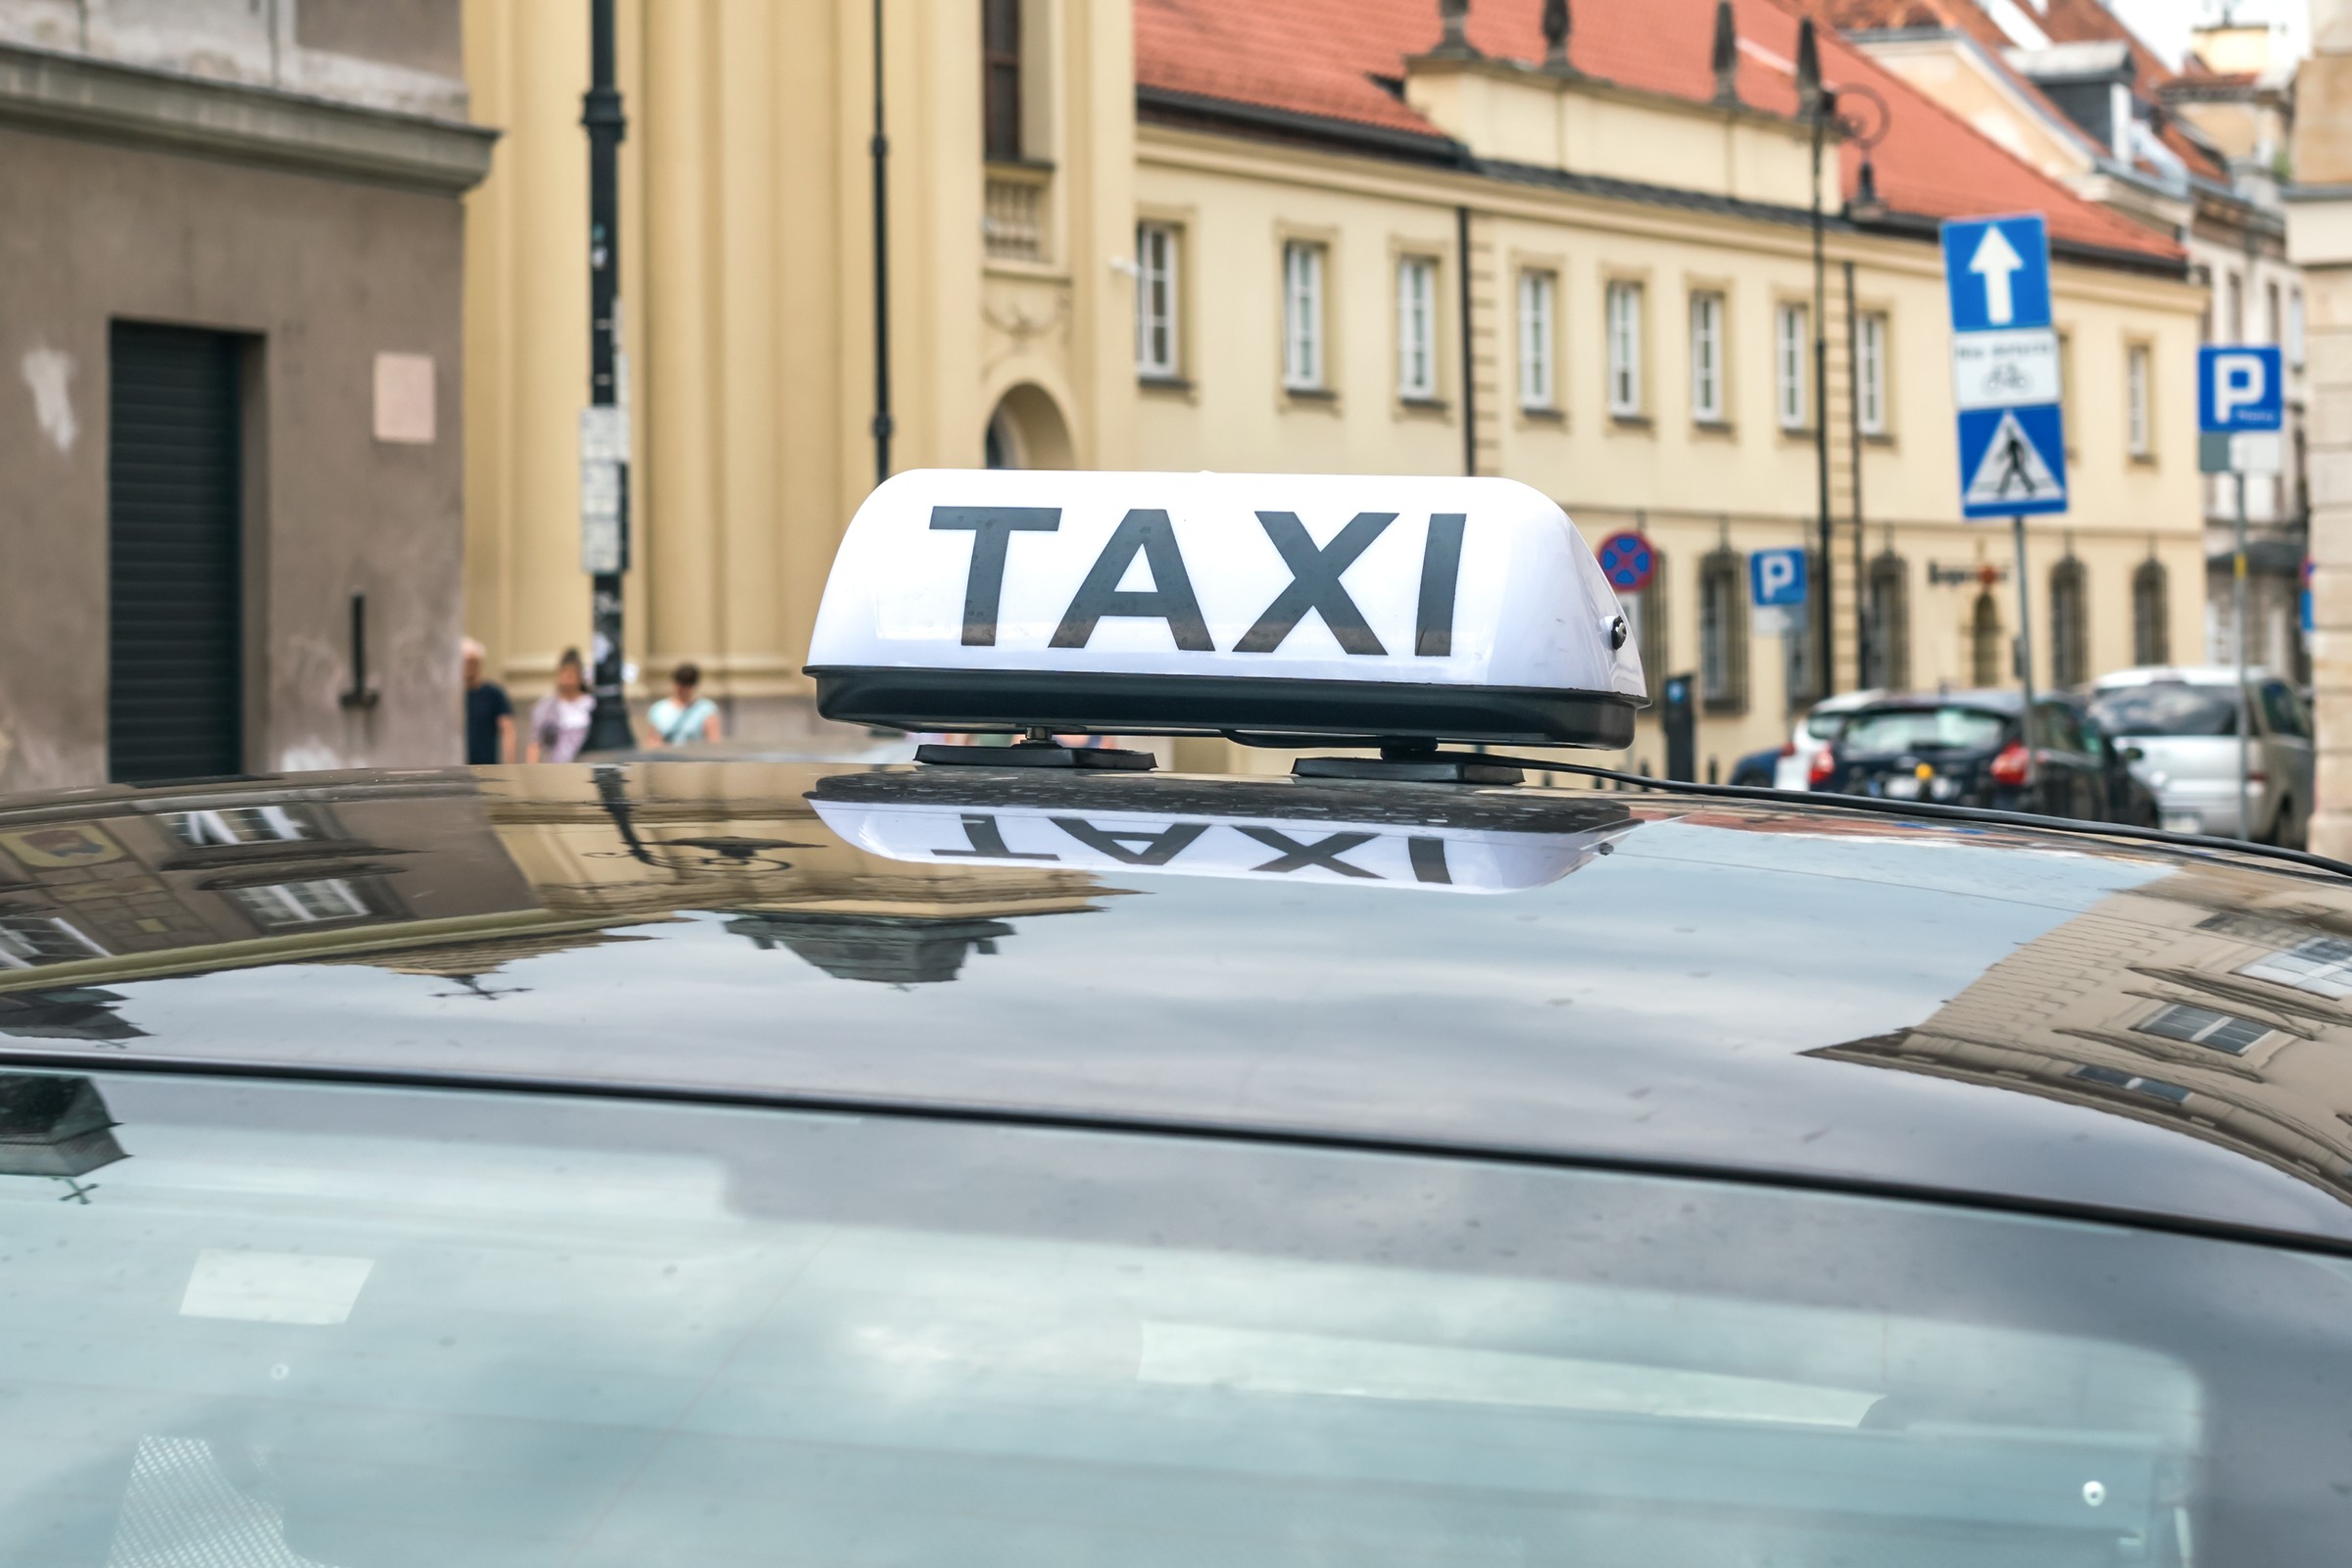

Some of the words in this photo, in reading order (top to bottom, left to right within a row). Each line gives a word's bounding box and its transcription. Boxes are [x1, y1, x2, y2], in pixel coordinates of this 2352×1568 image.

[2214, 354, 2266, 423] P
[928, 506, 1467, 657] TAXI
[1761, 555, 1794, 599] P
